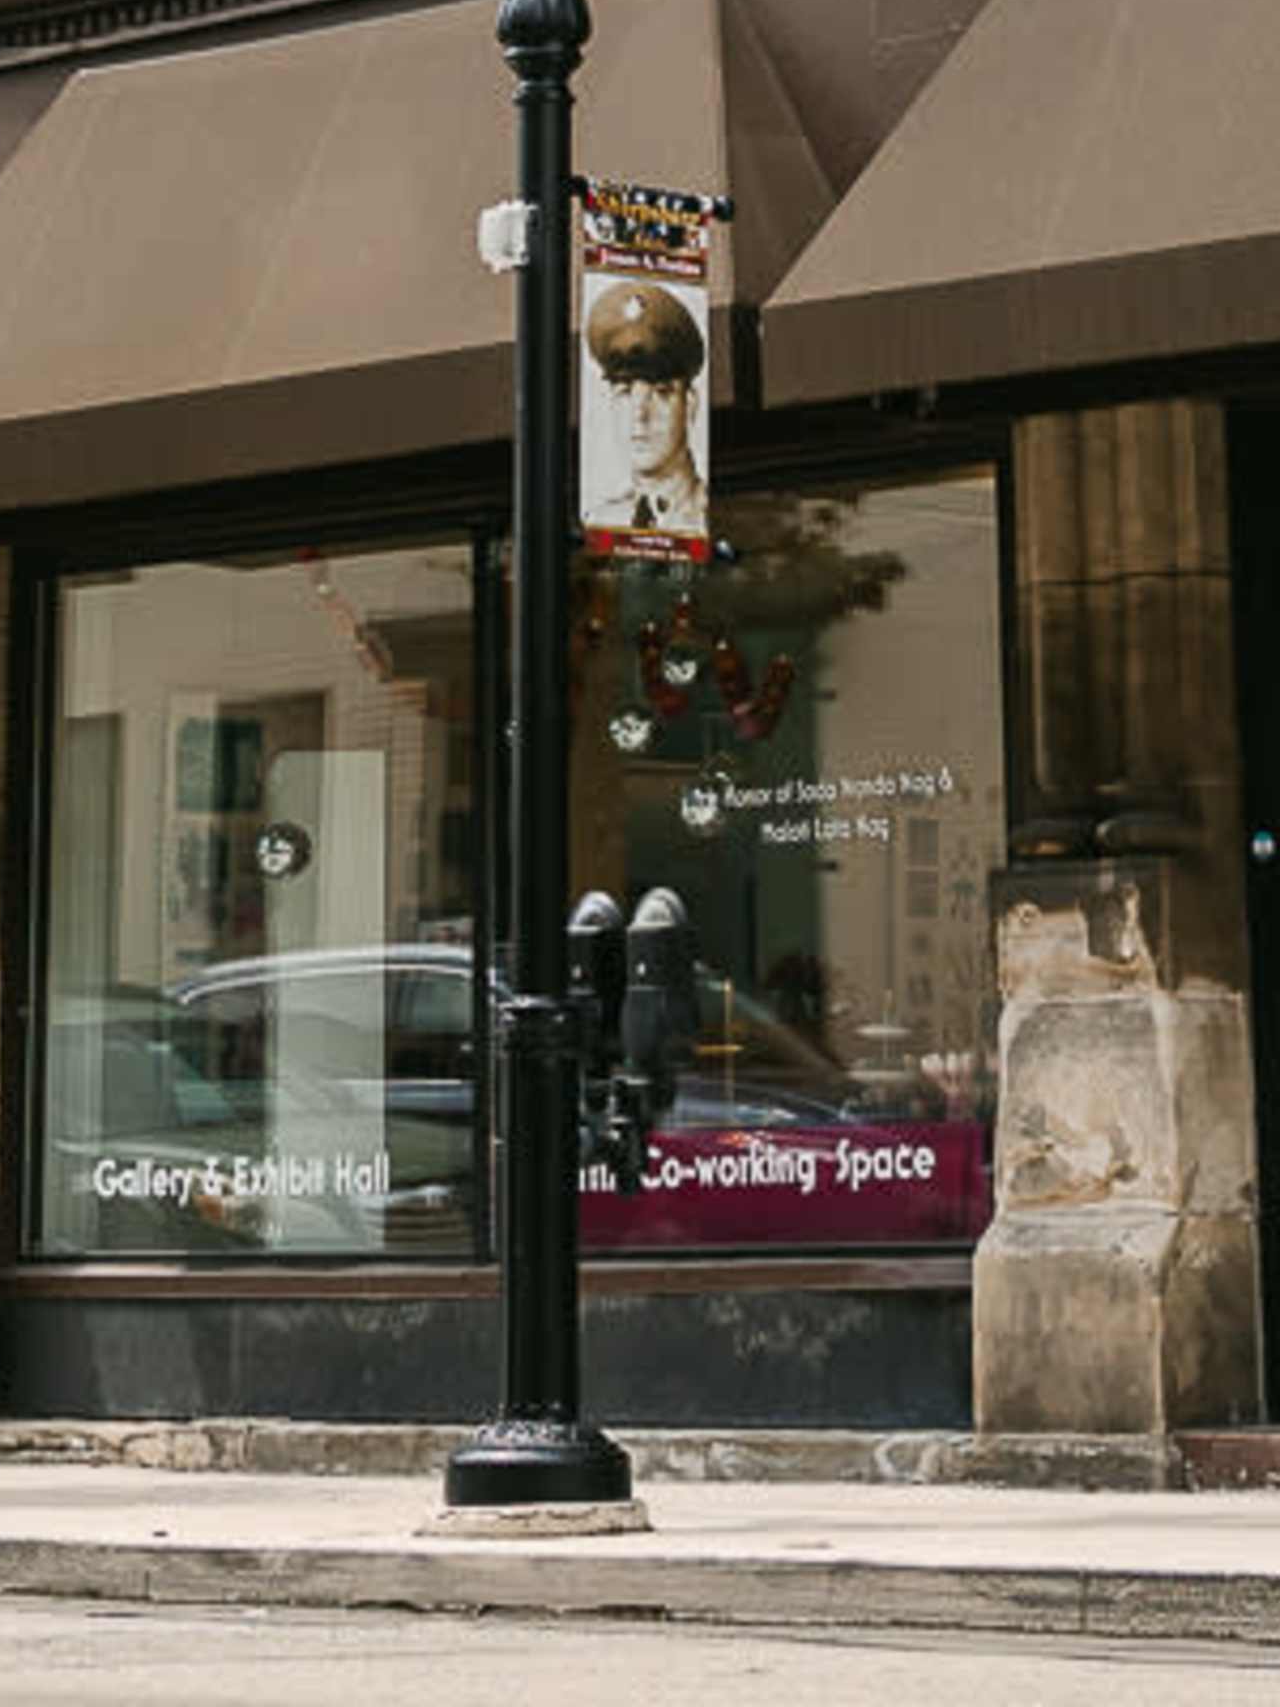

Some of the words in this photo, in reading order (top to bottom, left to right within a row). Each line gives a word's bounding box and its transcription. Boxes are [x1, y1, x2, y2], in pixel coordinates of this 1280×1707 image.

[93, 1158, 194, 1208] Gallery
[203, 1156, 224, 1196] &
[232, 1154, 325, 1196] Exhibit
[334, 1151, 391, 1196] Hall
[834, 1138, 935, 1192] Space
